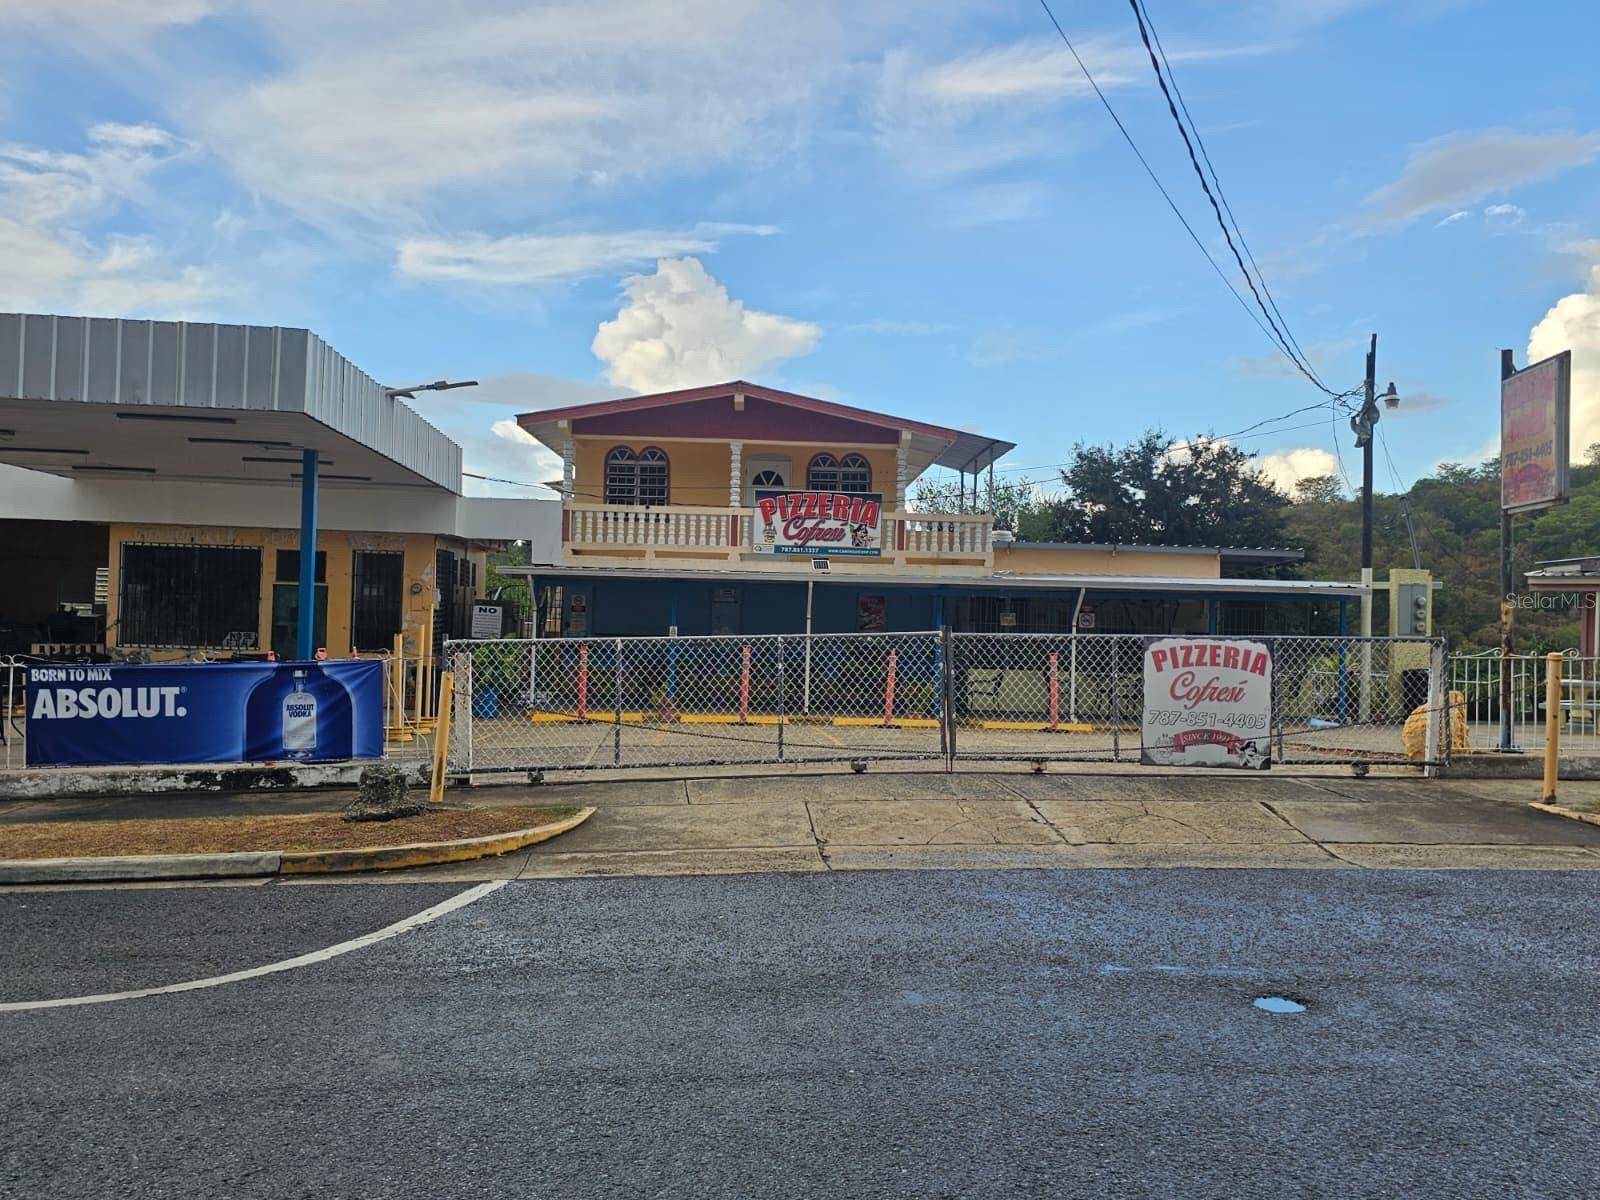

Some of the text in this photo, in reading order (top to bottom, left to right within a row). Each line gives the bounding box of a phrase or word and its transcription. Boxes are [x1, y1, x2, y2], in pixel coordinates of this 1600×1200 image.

[758, 493, 880, 529] PIZZERIA
[478, 606, 498, 614] NO
[1151, 644, 1269, 677] PIZZERIA
[31, 668, 113, 682] BORN TO MIX
[1169, 670, 1249, 710] Cofresí
[31, 686, 188, 719] ABSOLUT.
[288, 710, 312, 718] VODKA
[1148, 710, 1266, 729] 787-851-4405
[1183, 733, 1210, 743] SINCE
